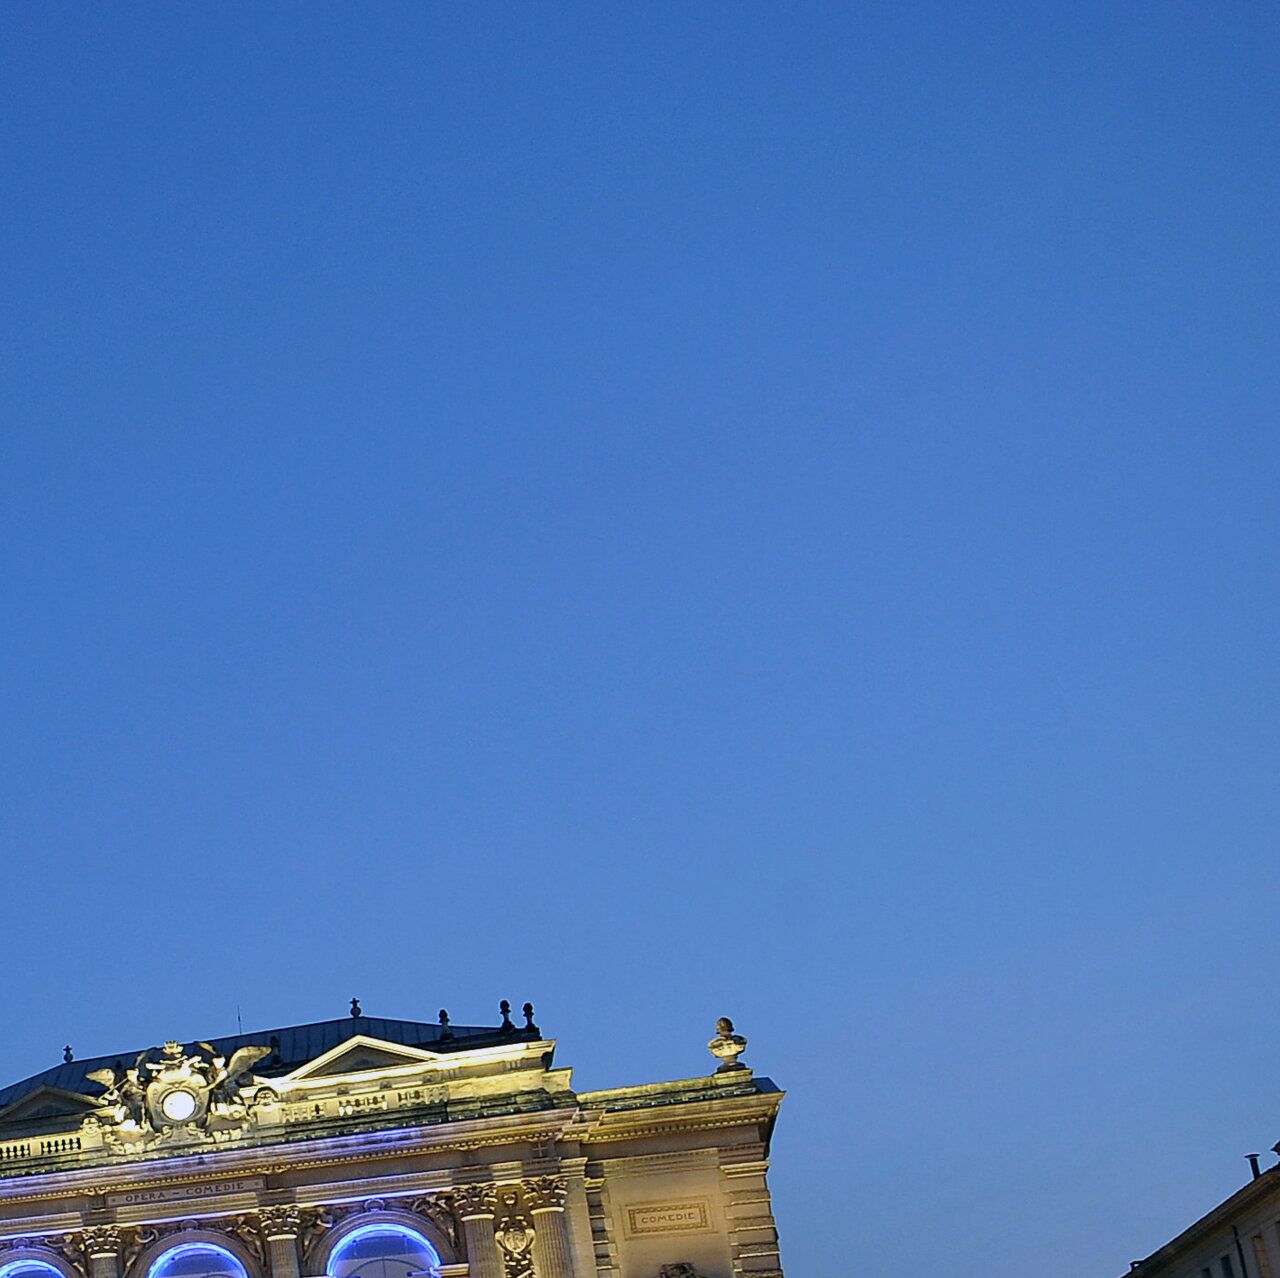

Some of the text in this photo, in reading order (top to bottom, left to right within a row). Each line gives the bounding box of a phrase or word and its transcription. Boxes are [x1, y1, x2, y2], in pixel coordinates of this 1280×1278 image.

[125, 1191, 165, 1202] OPERA
[185, 1181, 244, 1196] COMEDIE
[641, 1212, 695, 1223] COMEDIE
